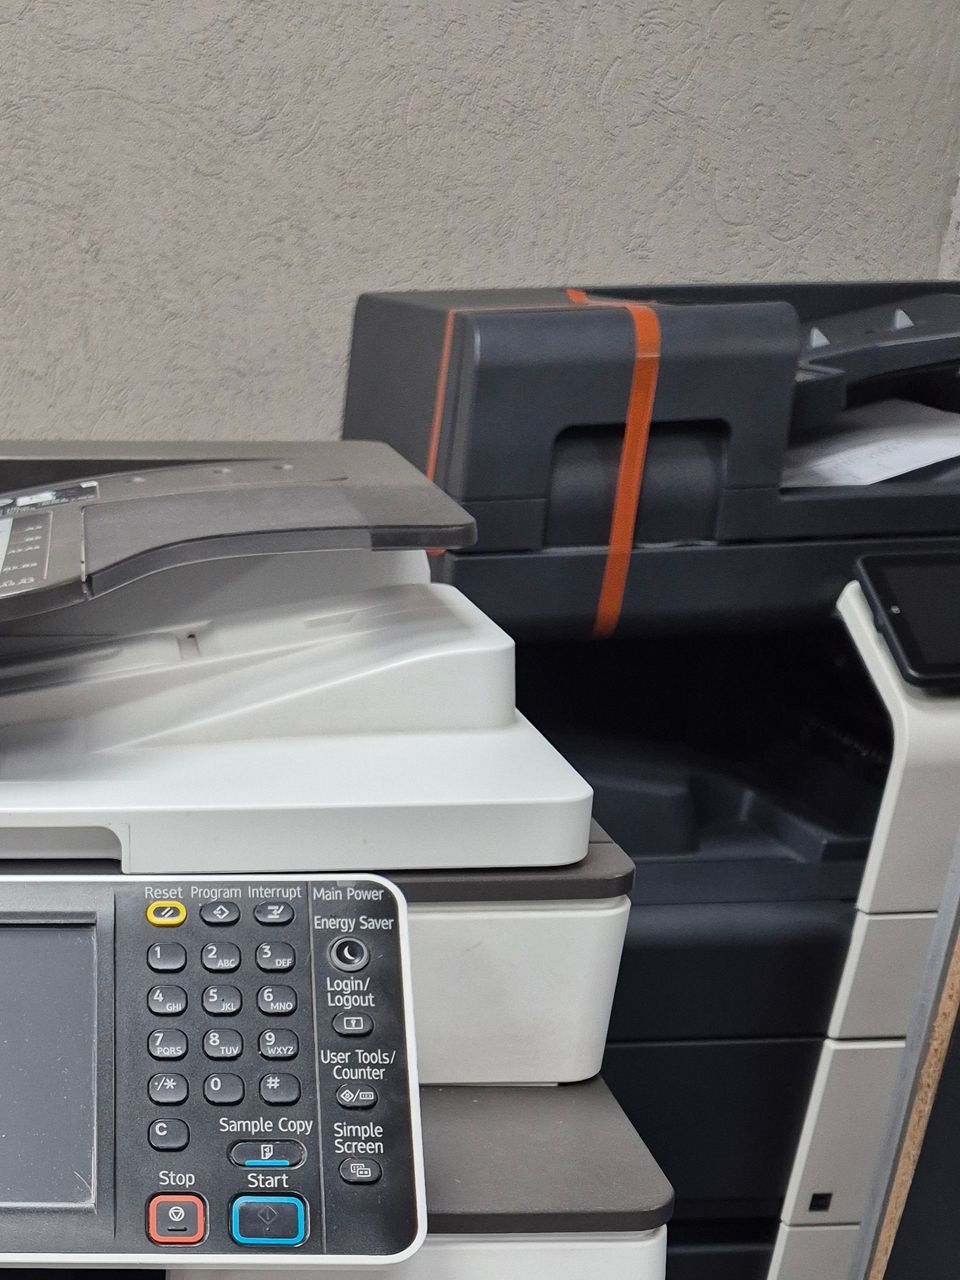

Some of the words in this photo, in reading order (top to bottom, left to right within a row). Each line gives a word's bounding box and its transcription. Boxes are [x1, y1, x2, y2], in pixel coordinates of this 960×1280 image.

[145, 887, 182, 898] Reset
[191, 887, 241, 901] Program
[248, 886, 301, 901] Interrupt
[313, 888, 342, 900] Main
[348, 888, 384, 900] Power
[315, 917, 354, 931] Energy
[360, 917, 394, 930] Saver
[155, 946, 161, 958] 1
[207, 946, 217, 958] 2
[217, 959, 235, 967] ABC
[262, 946, 271, 958] 3
[275, 959, 292, 967] DEF
[327, 977, 369, 994] Login/
[153, 989, 163, 1002] 4
[166, 1002, 182, 1011] GHI
[208, 989, 218, 1002] 5
[221, 1002, 235, 1010] JKL
[263, 988, 273, 1001] 6
[270, 1002, 293, 1010] MNO
[328, 993, 375, 1009] Logout
[155, 1033, 163, 1046] 7
[209, 1033, 220, 1045] 8
[220, 1046, 239, 1055] TUV
[265, 1033, 275, 1045] 9
[157, 1047, 182, 1055] PQRS
[267, 1046, 293, 1054] WXYZ
[321, 1051, 352, 1064] User
[355, 1050, 396, 1064] Tools/
[333, 1066, 385, 1080] Counter
[210, 1077, 221, 1091] 0
[267, 1076, 280, 1089] #
[155, 1123, 167, 1135] C
[220, 1118, 273, 1135] Sample
[279, 1118, 313, 1135] Copy
[334, 1122, 383, 1140] Simple
[335, 1140, 383, 1154] Screen
[159, 1171, 195, 1188] Stop
[248, 1174, 288, 1188] Start
